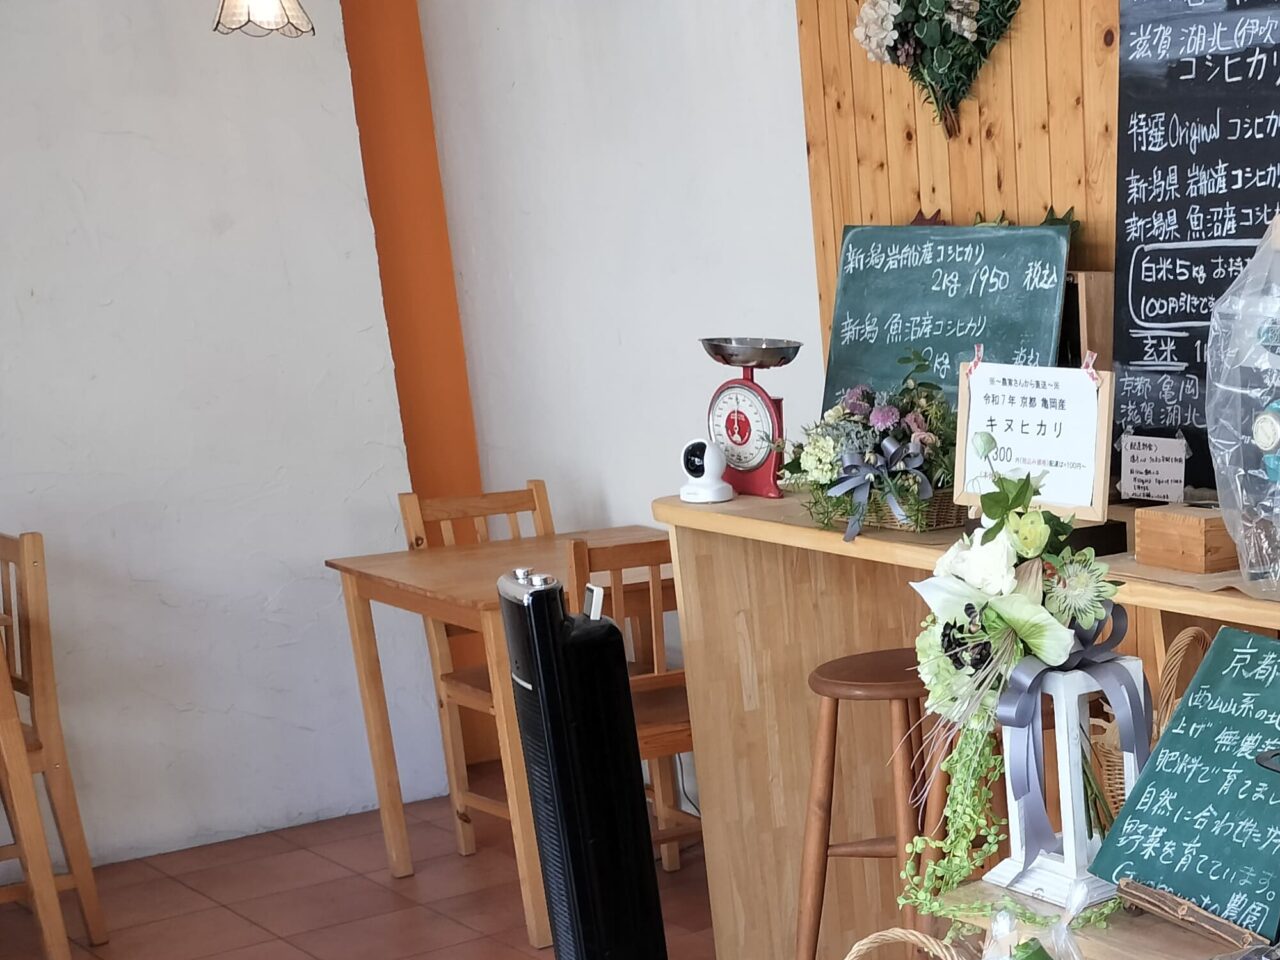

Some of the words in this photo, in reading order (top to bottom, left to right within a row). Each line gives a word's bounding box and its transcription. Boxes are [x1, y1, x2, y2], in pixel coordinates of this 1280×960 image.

[1124, 168, 1181, 205] 新潟県
[1125, 208, 1181, 242] 新潟県
[969, 264, 1010, 297] 1950
[1143, 334, 1178, 363] 玄米
[983, 392, 1016, 408] 令和7年
[1020, 396, 1037, 409] 京都
[1041, 397, 1067, 411] 亀岡産
[986, 415, 1062, 438] キヌヒカリ
